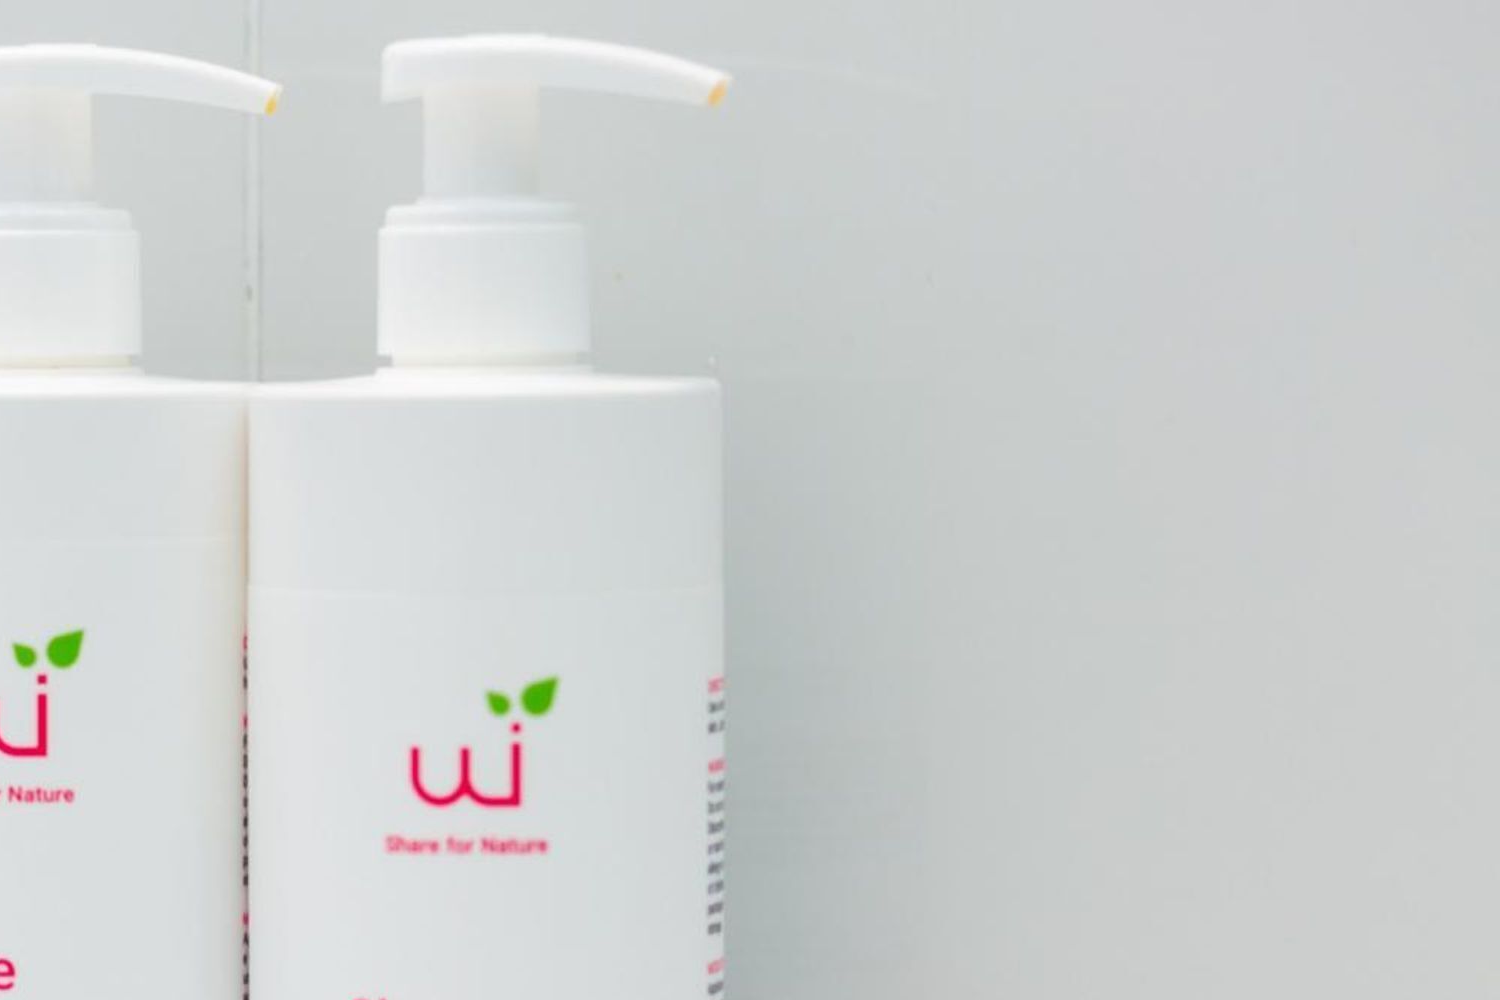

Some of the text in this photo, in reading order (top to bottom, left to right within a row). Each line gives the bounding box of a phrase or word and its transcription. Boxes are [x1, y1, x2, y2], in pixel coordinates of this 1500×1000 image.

[8, 786, 75, 804] Nature
[385, 834, 549, 855] Share for Nature
